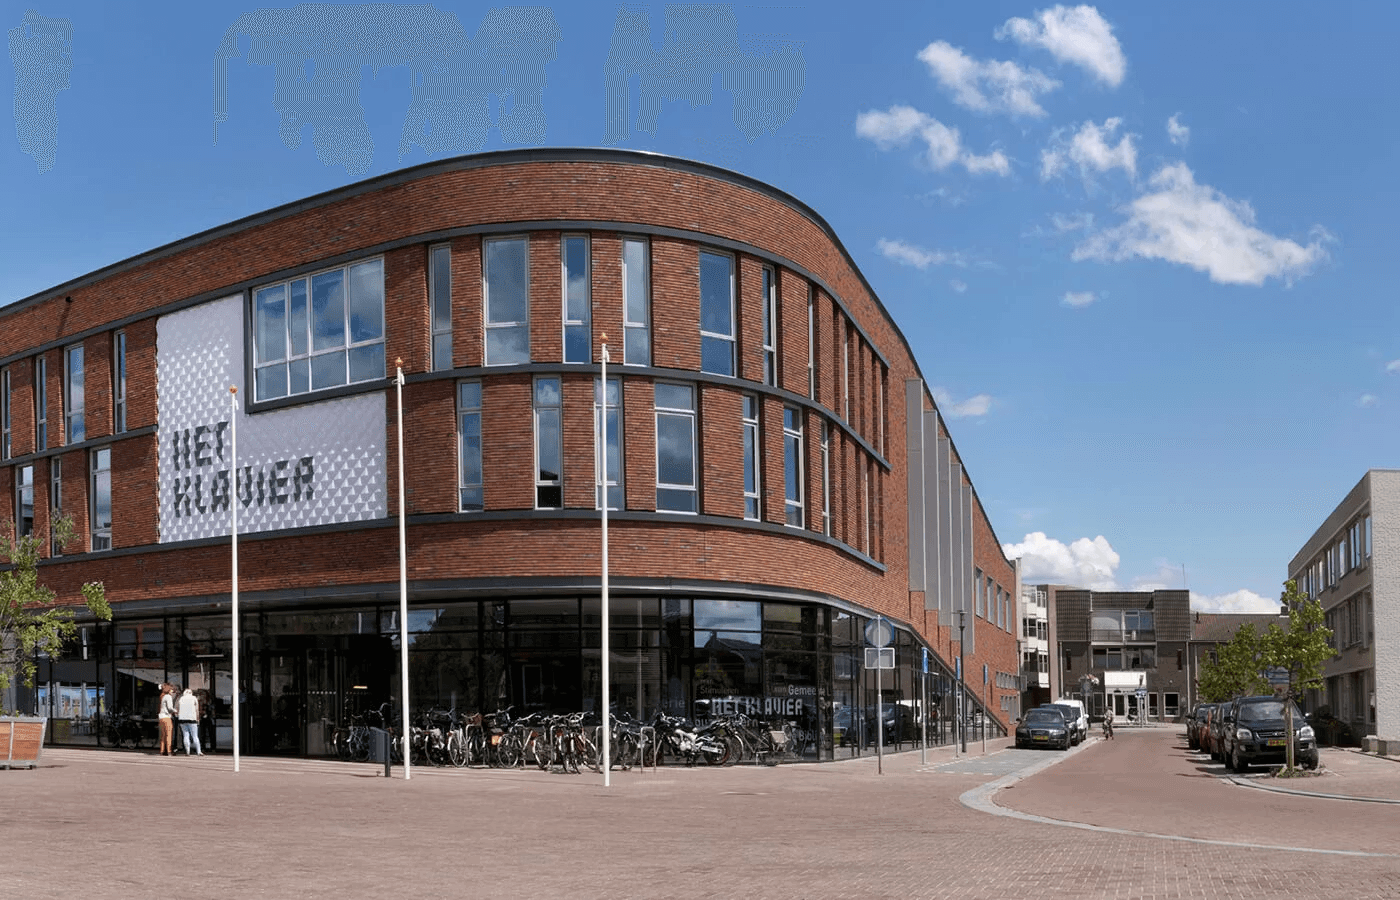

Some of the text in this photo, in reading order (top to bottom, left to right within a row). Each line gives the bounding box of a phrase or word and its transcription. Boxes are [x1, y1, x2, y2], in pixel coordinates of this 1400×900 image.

[173, 421, 229, 471] HET
[173, 456, 314, 518] KLAVIER
[745, 697, 804, 716] KLAVIER
